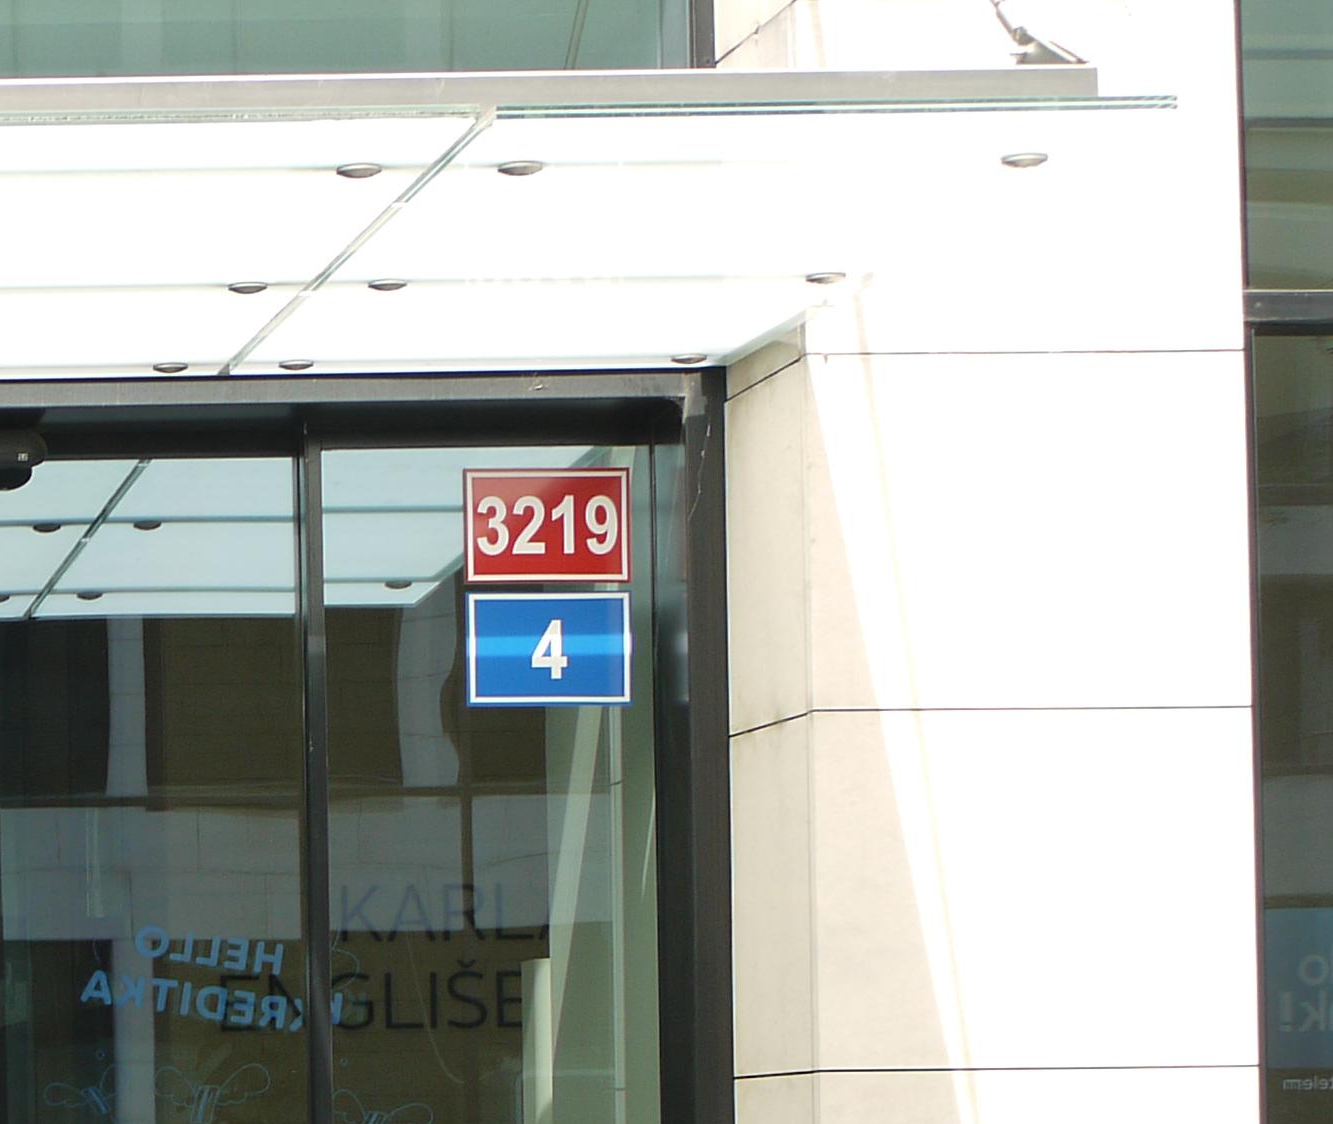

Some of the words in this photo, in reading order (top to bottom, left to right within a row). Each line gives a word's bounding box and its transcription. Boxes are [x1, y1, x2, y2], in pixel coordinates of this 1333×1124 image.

[476, 494, 619, 556] 3219
[531, 619, 569, 680] 4
[340, 880, 549, 942] KARL
